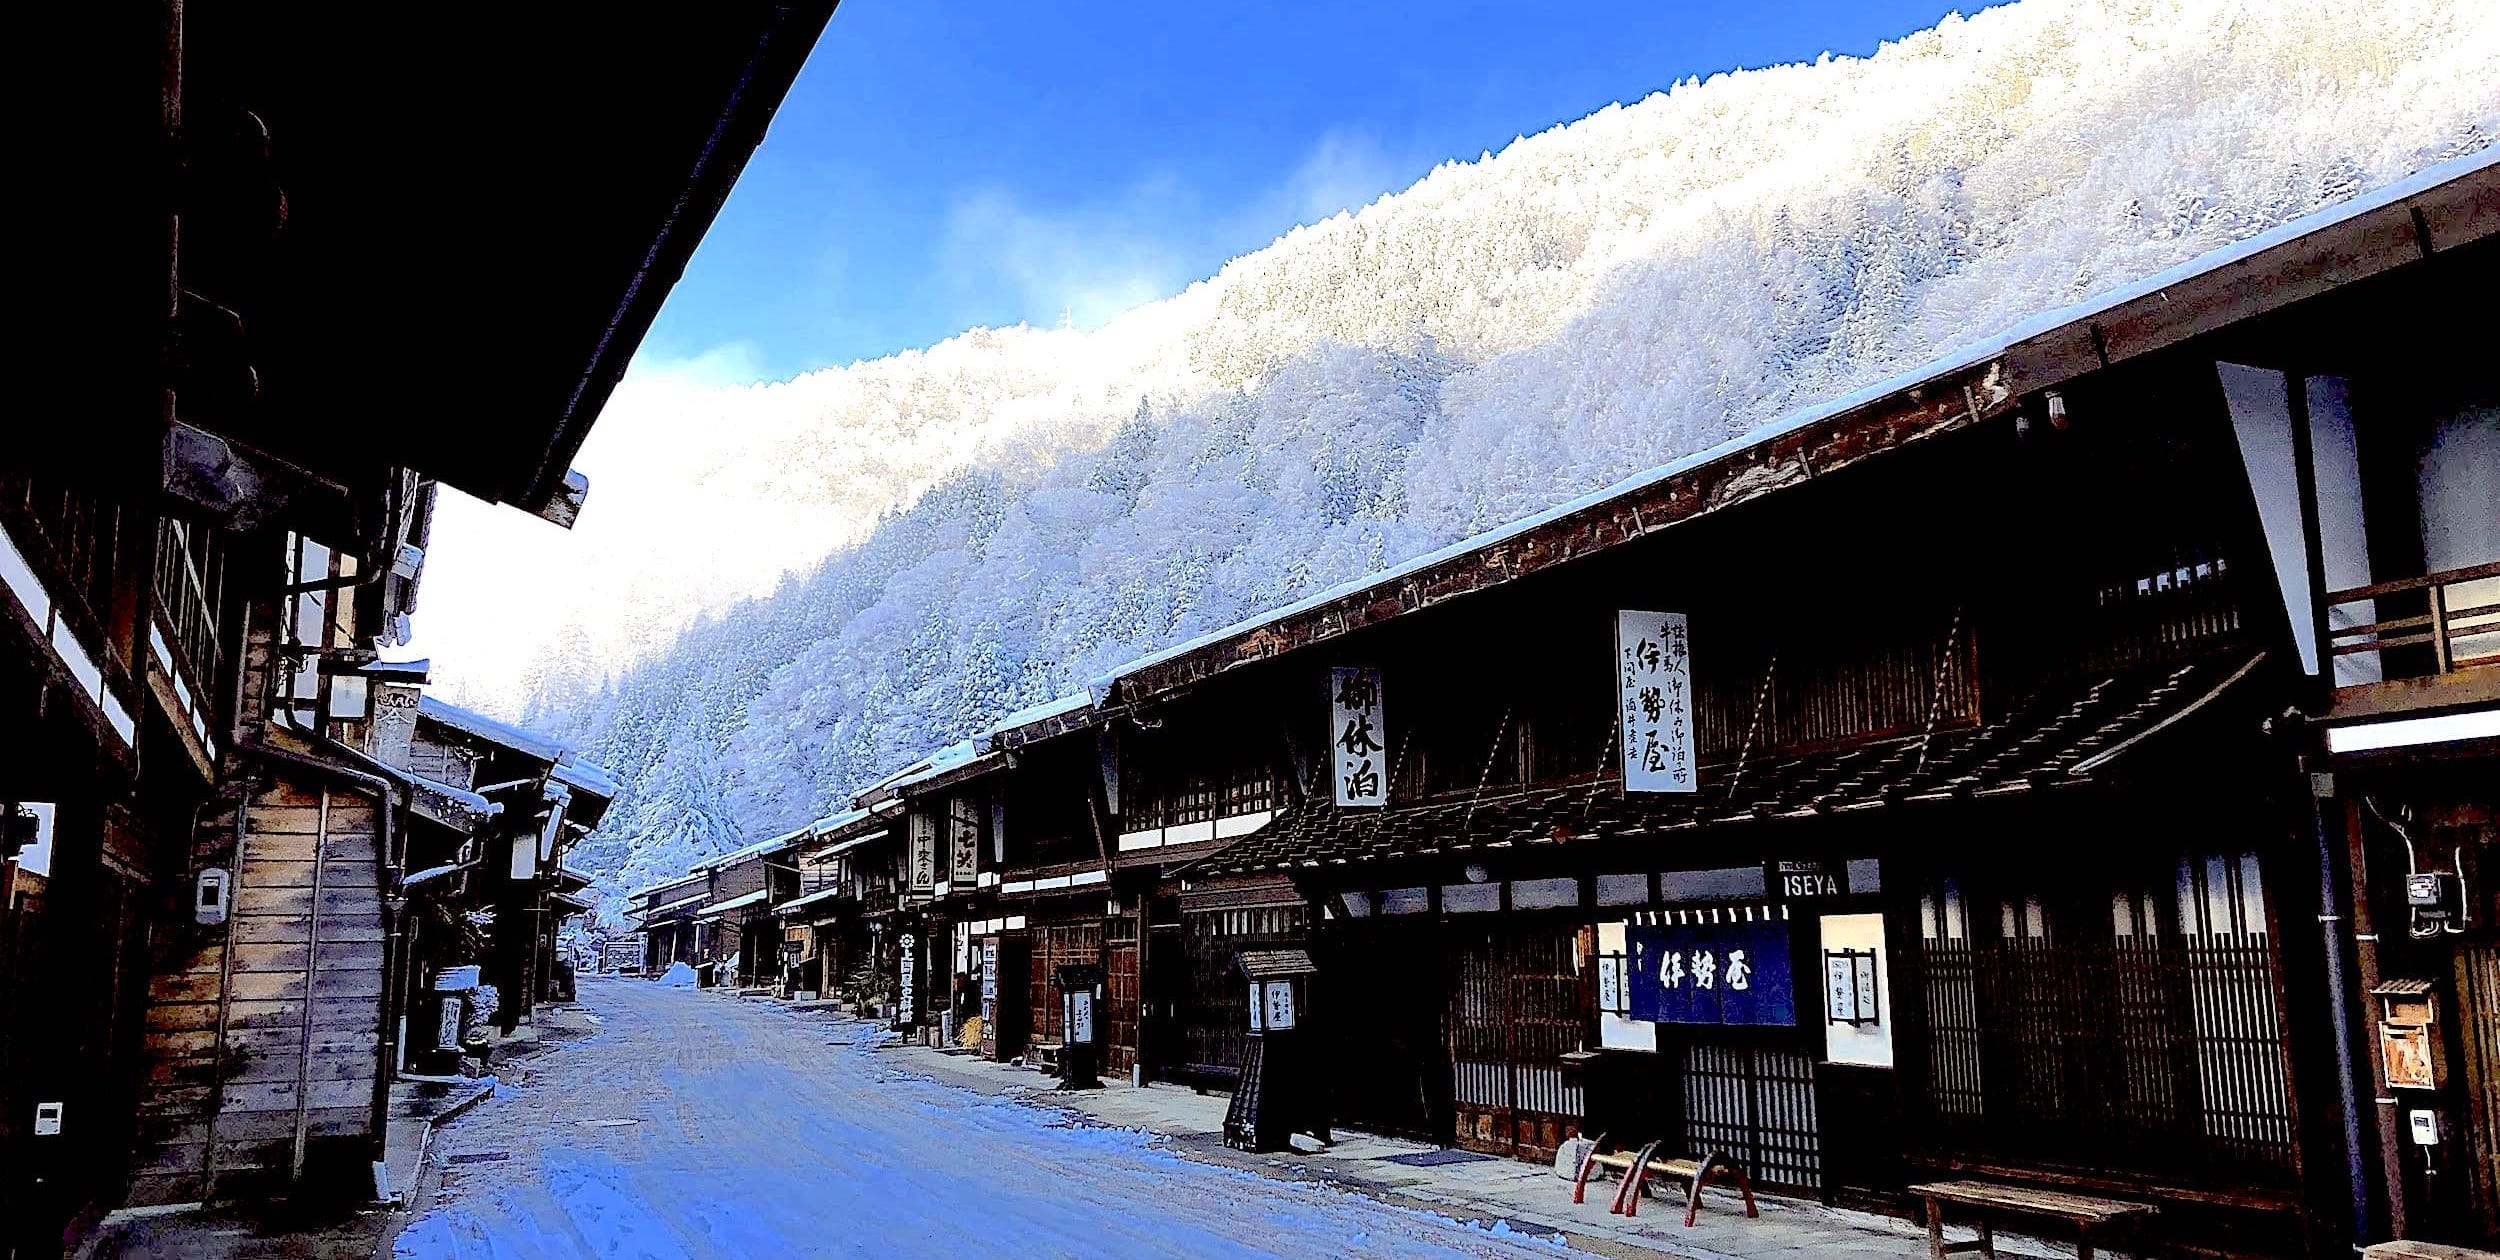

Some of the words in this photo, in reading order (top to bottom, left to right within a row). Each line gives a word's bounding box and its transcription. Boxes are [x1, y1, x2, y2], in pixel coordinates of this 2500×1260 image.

[1636, 637, 1670, 773] 伊勢屋
[1784, 874, 1838, 897] ISEYA
[1660, 949, 1751, 991] 伊勢屋
[1271, 990, 1282, 1022] 伊勢屋
